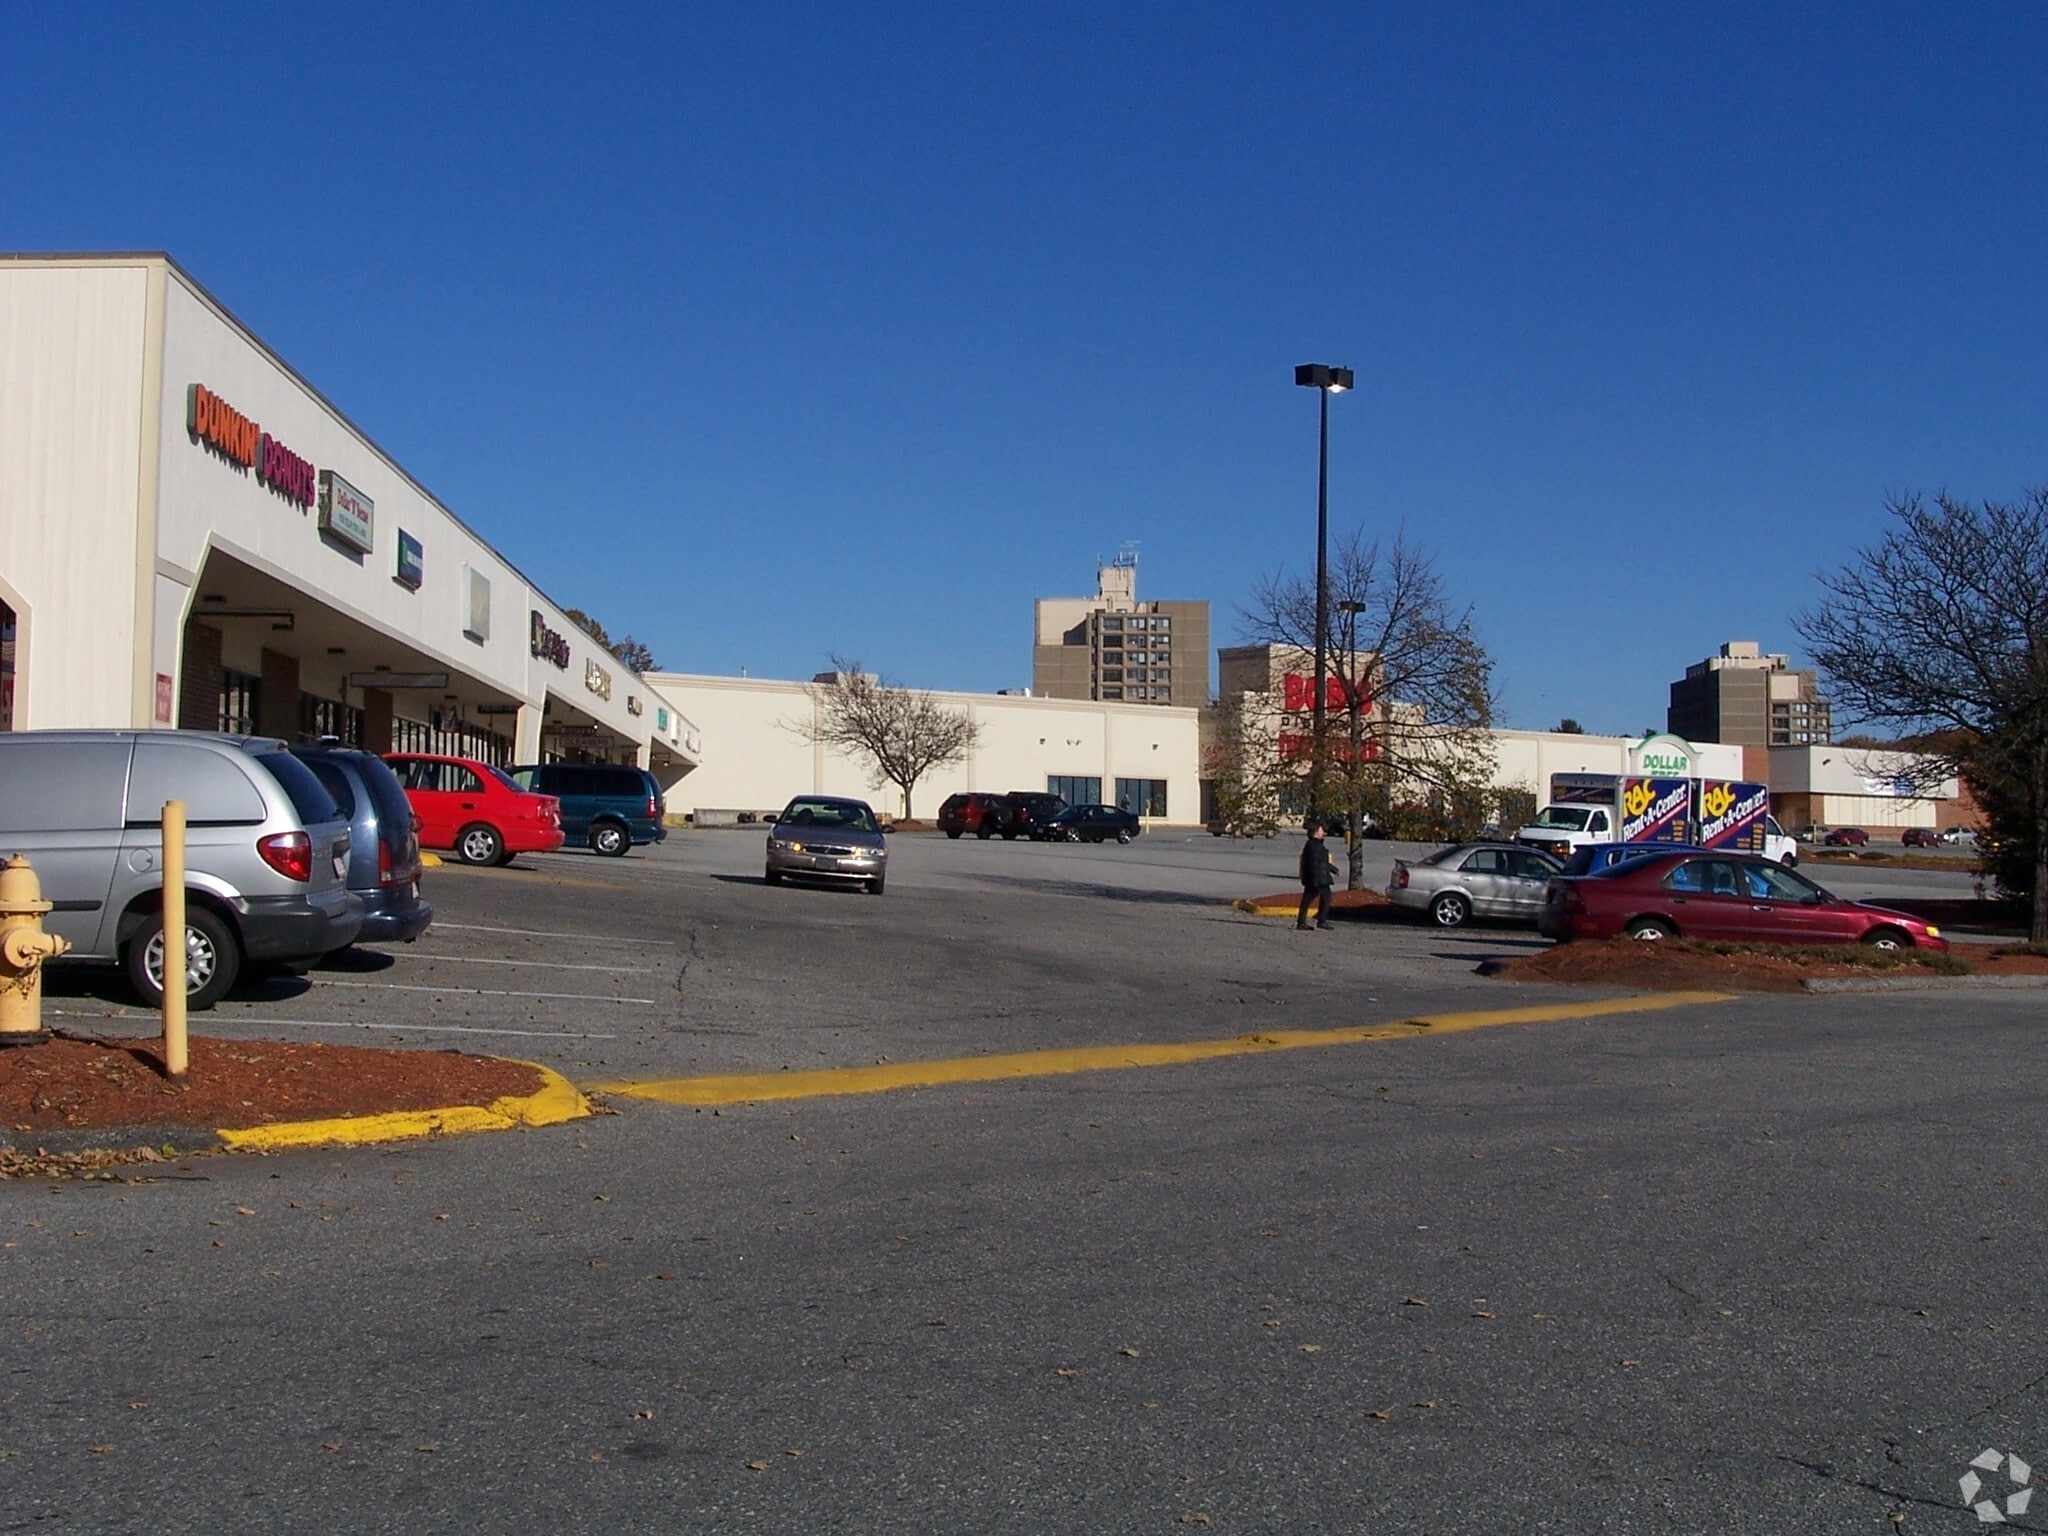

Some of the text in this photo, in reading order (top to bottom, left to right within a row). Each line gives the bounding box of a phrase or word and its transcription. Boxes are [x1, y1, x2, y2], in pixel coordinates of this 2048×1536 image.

[195, 383, 261, 467] DUNKIN'
[263, 432, 315, 508] DONUTS
[1643, 754, 1688, 770] DOLLAR
